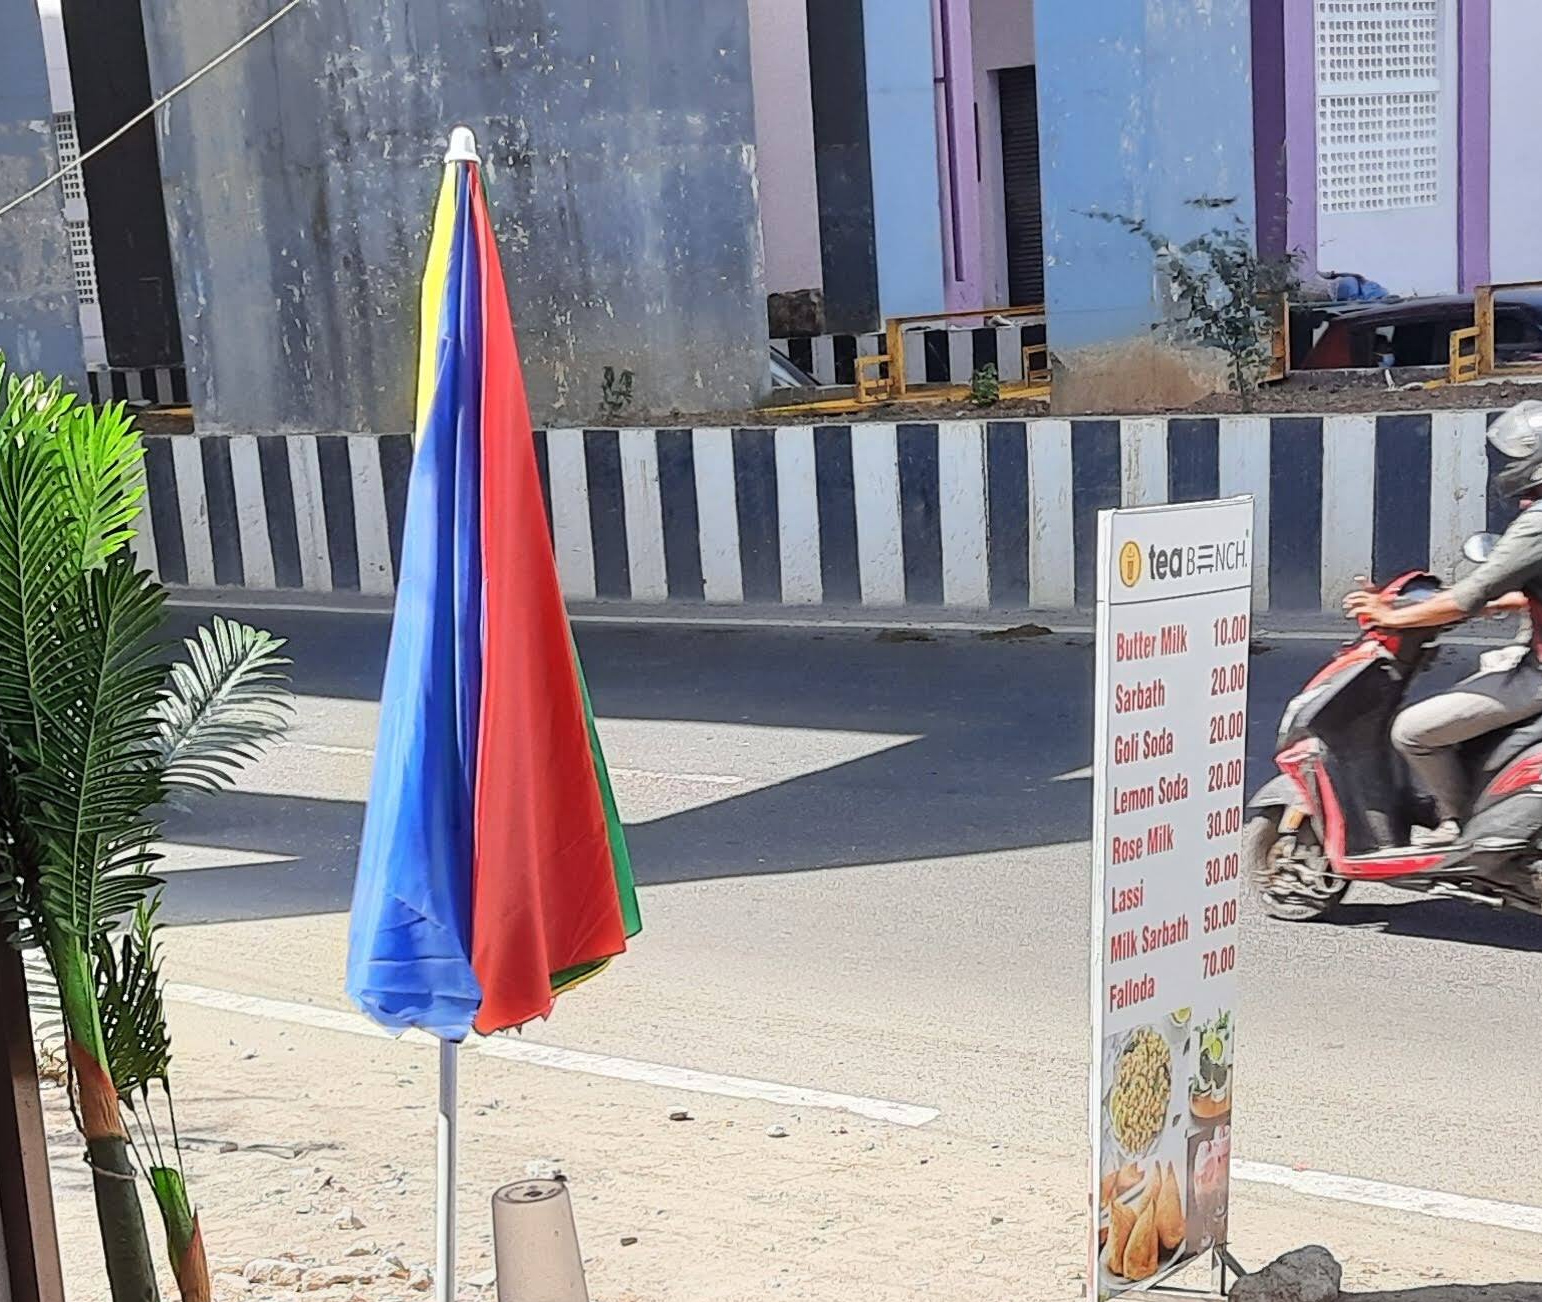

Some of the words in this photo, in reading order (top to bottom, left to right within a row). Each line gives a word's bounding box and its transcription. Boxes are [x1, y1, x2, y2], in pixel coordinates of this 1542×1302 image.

[1148, 543, 1183, 580] tea
[1116, 632, 1156, 662] Butter
[1161, 624, 1188, 656] Milk
[1213, 614, 1247, 647] 10.00
[1115, 678, 1165, 714] Sarbath
[1211, 663, 1245, 697] 20.00
[1114, 734, 1139, 765] Goli
[1143, 727, 1173, 759] Soda
[1210, 711, 1243, 744] 20.00
[1113, 786, 1154, 815] Lemon
[1159, 773, 1189, 805] Soda
[1208, 758, 1242, 792] 20.00
[1112, 836, 1143, 865] Rose
[1147, 823, 1174, 856] Milk
[1206, 806, 1240, 840] 30.00
[1111, 880, 1144, 915] Lassi
[1205, 852, 1239, 887] 30.00
[1110, 930, 1137, 964] Milk
[1142, 914, 1189, 954] Sarbath
[1203, 899, 1237, 934] 50.00
[1109, 973, 1155, 1013] Falloda
[1202, 944, 1235, 979] 70.00
